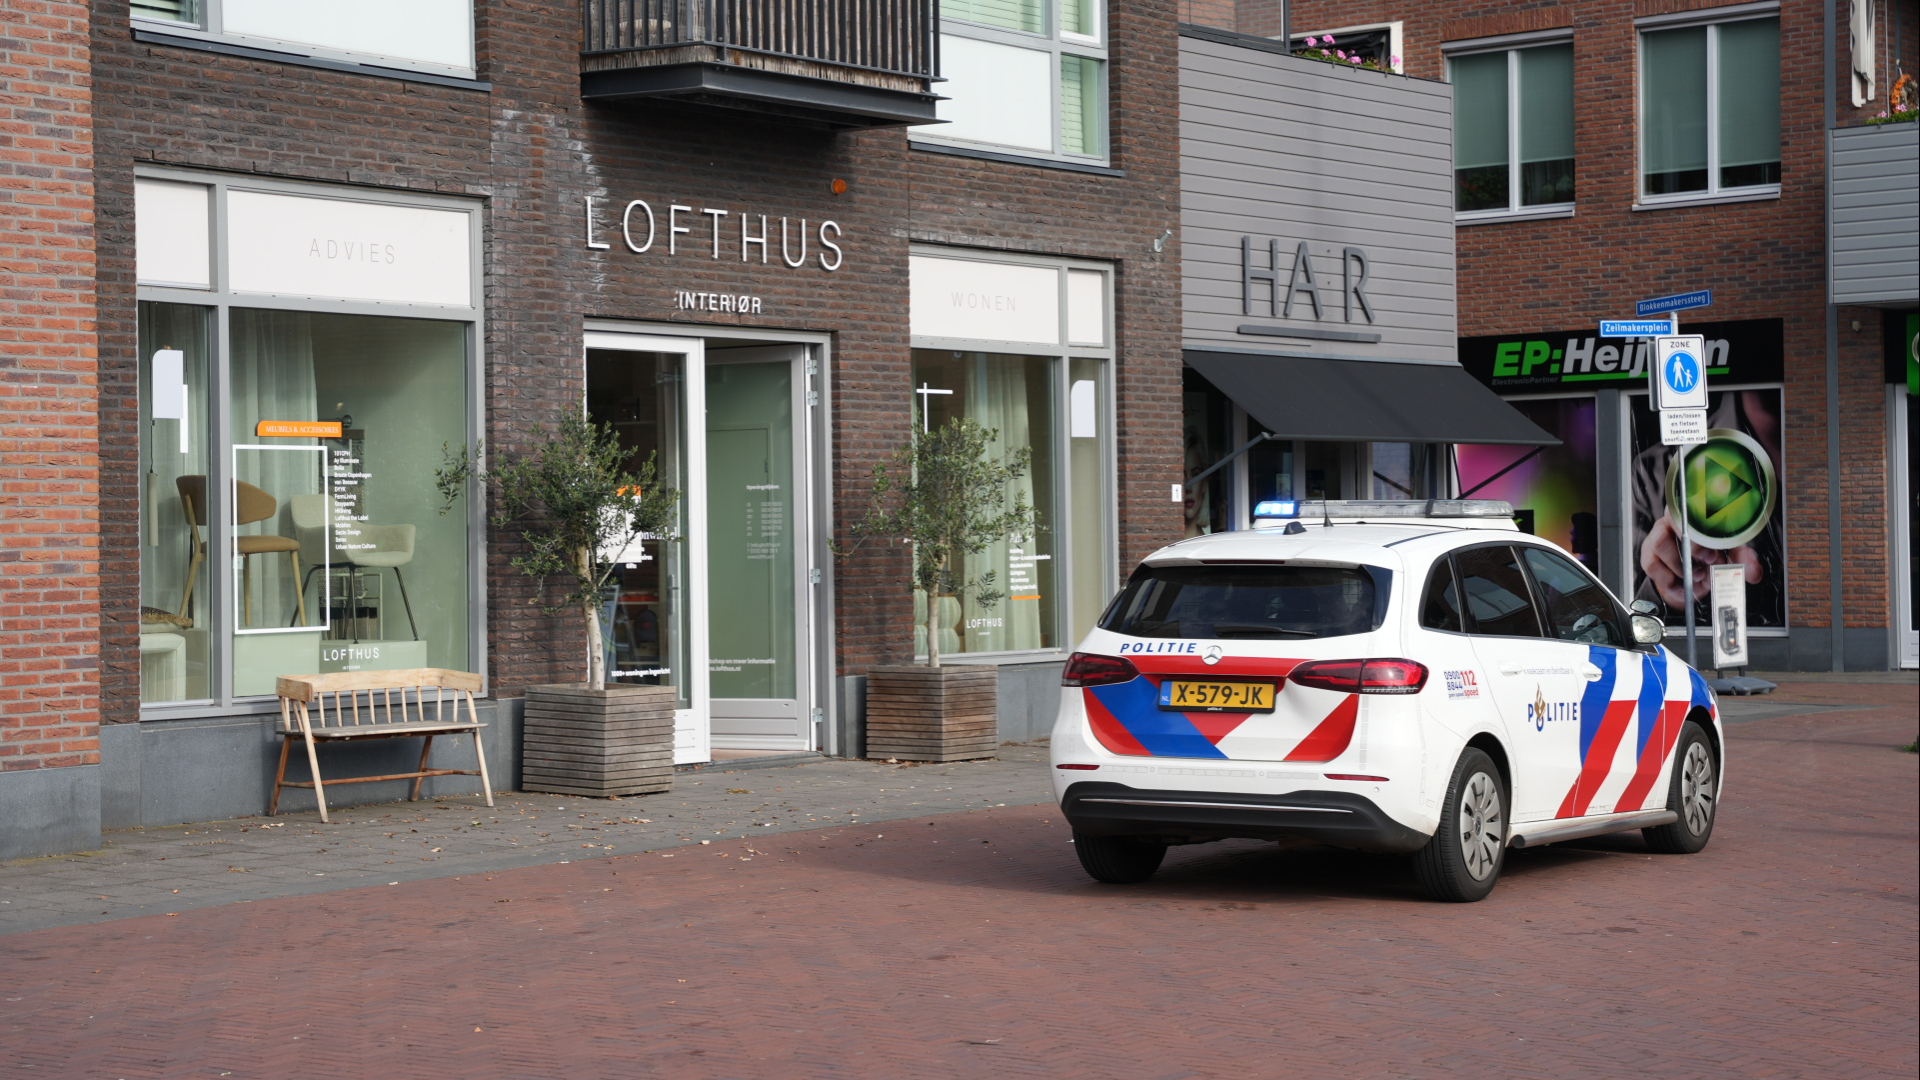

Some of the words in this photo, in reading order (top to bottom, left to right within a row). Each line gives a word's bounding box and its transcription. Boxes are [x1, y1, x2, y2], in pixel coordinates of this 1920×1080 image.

[584, 192, 843, 272] LOFTHUS
[309, 238, 396, 265] ADVIES
[1241, 235, 1376, 324] HAR
[951, 292, 1017, 312] WONEN
[1639, 294, 1706, 312] Blokkenmakerssteeg
[1605, 323, 1669, 334] Zeilmakersplein
[1670, 341, 1691, 349] ZONE
[1491, 376, 1559, 386] ElectronicPartner
[265, 425, 293, 433] MEUBELS
[299, 426, 339, 434] ACCESSOIRES
[966, 617, 1003, 629] LOFTHUS
[323, 647, 380, 661] LOFTHUS
[1119, 642, 1197, 653] POLITIE
[1443, 670, 1461, 680] 0900
[1460, 670, 1477, 686] 112
[1447, 681, 1463, 691] 8844
[1176, 684, 1263, 706] X-579-JK
[1464, 687, 1479, 699] spoed
[1528, 702, 1578, 732] POLITIE
